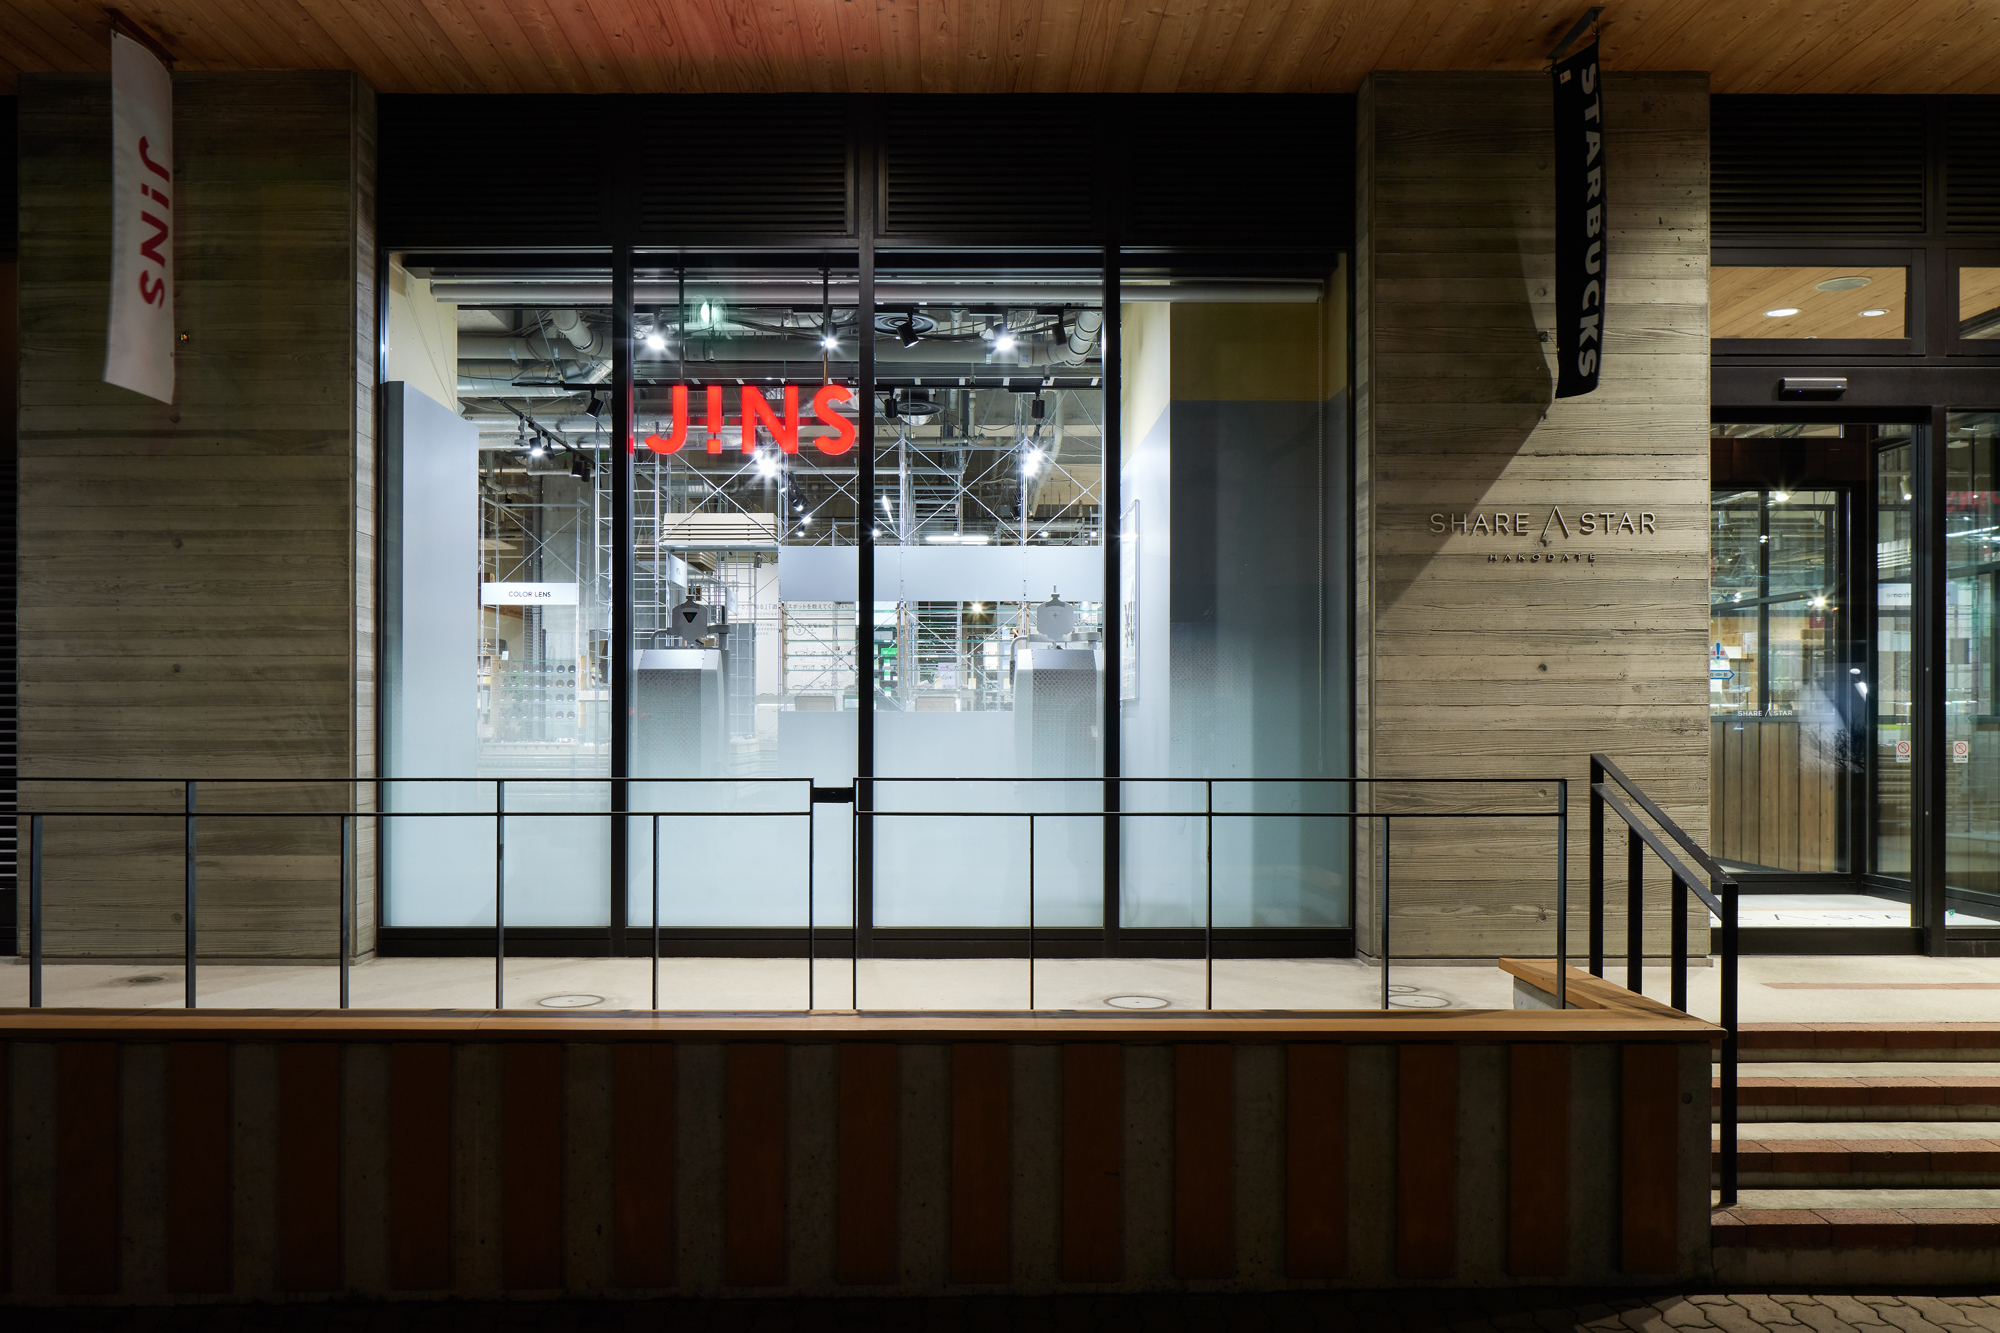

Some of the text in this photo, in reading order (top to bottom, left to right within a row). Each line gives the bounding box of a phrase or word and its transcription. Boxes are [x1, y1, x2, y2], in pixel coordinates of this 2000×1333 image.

[1578, 62, 1600, 377] STARBUCKS
[1430, 513, 1530, 533] SHARE
[1580, 512, 1656, 533] STAR
[1489, 553, 1596, 561] HAKODATE
[508, 590, 533, 598] COLOR
